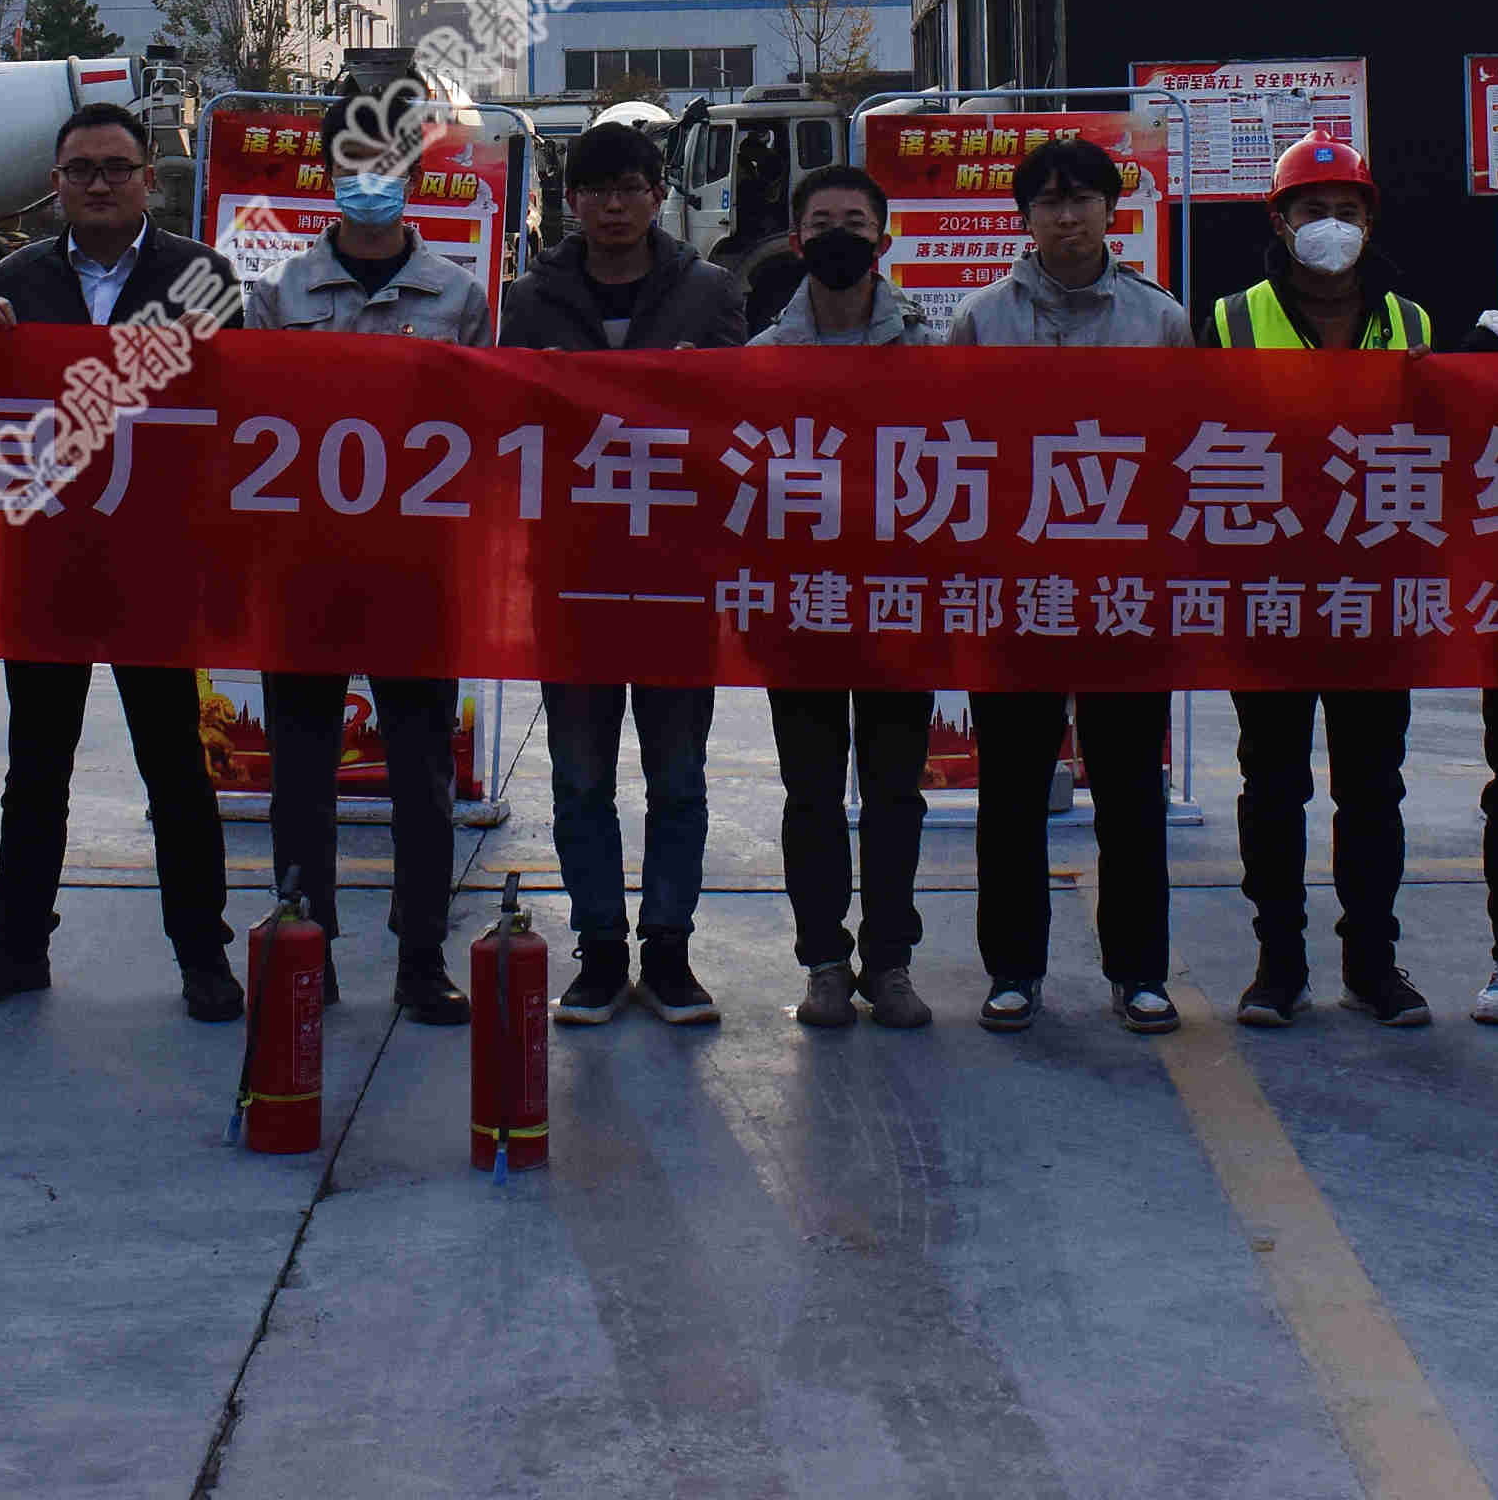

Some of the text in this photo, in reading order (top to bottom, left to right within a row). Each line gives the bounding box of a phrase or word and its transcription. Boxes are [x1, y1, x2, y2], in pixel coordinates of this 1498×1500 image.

[1163, 71, 1336, 90] 生命至高无上 安全责任为天
[898, 127, 1082, 156] 落实消防责任
